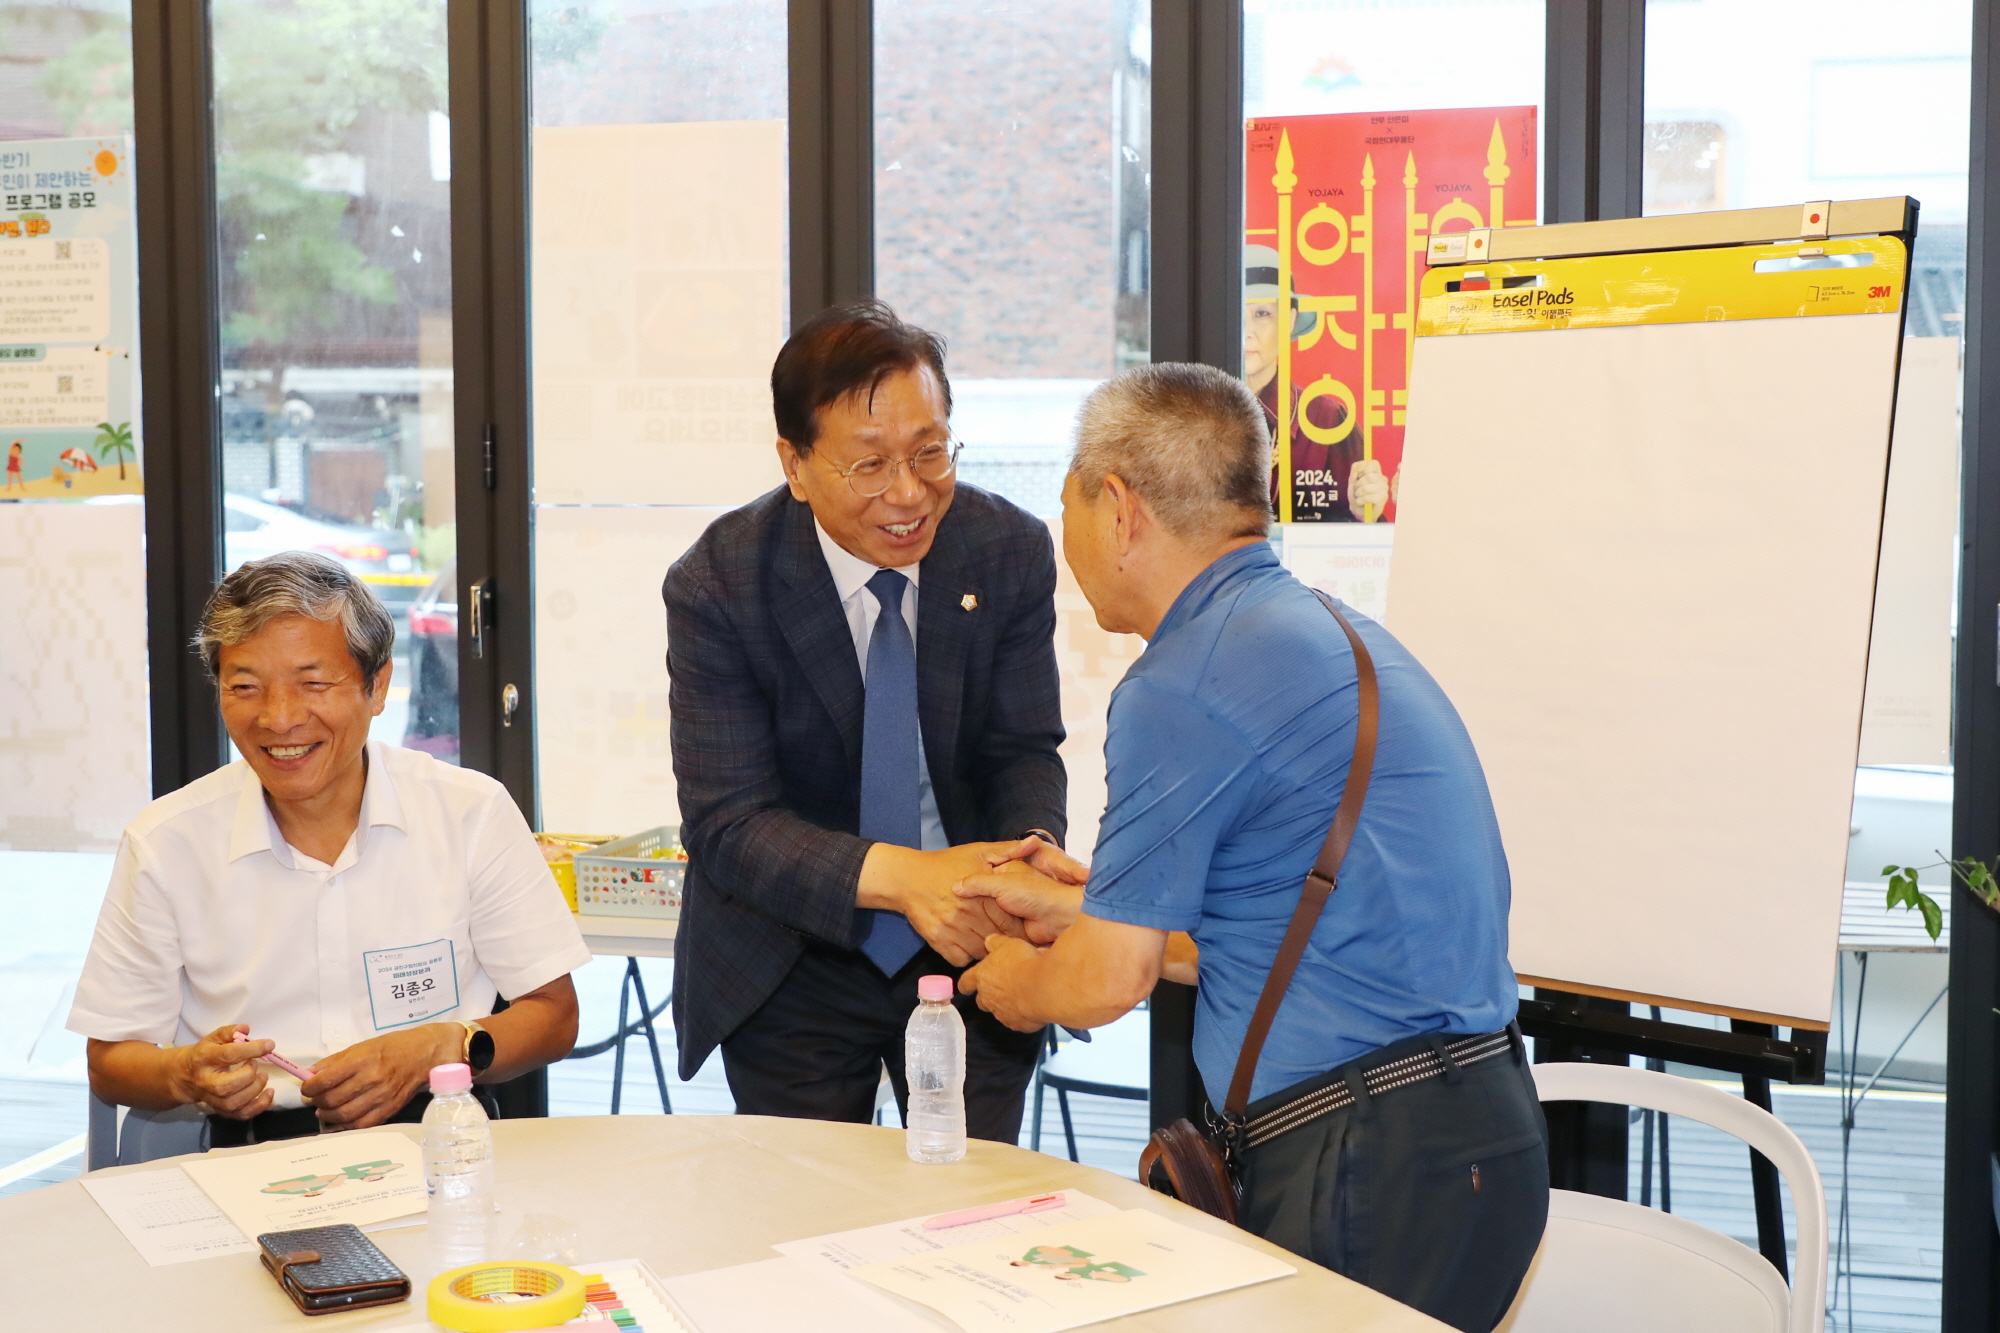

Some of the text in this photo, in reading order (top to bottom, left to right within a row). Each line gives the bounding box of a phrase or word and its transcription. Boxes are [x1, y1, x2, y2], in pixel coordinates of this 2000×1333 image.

[0, 152, 30, 170] 반기
[1308, 183, 1473, 198] YOJAYA YOJAYA
[5, 192, 96, 212] 프로그램 공모
[1493, 287, 1575, 308] Easel Pads
[1868, 286, 1891, 298] 3M
[1296, 469, 1338, 486] 2024.
[378, 966, 393, 974] 2024
[391, 978, 436, 999] 김종오
